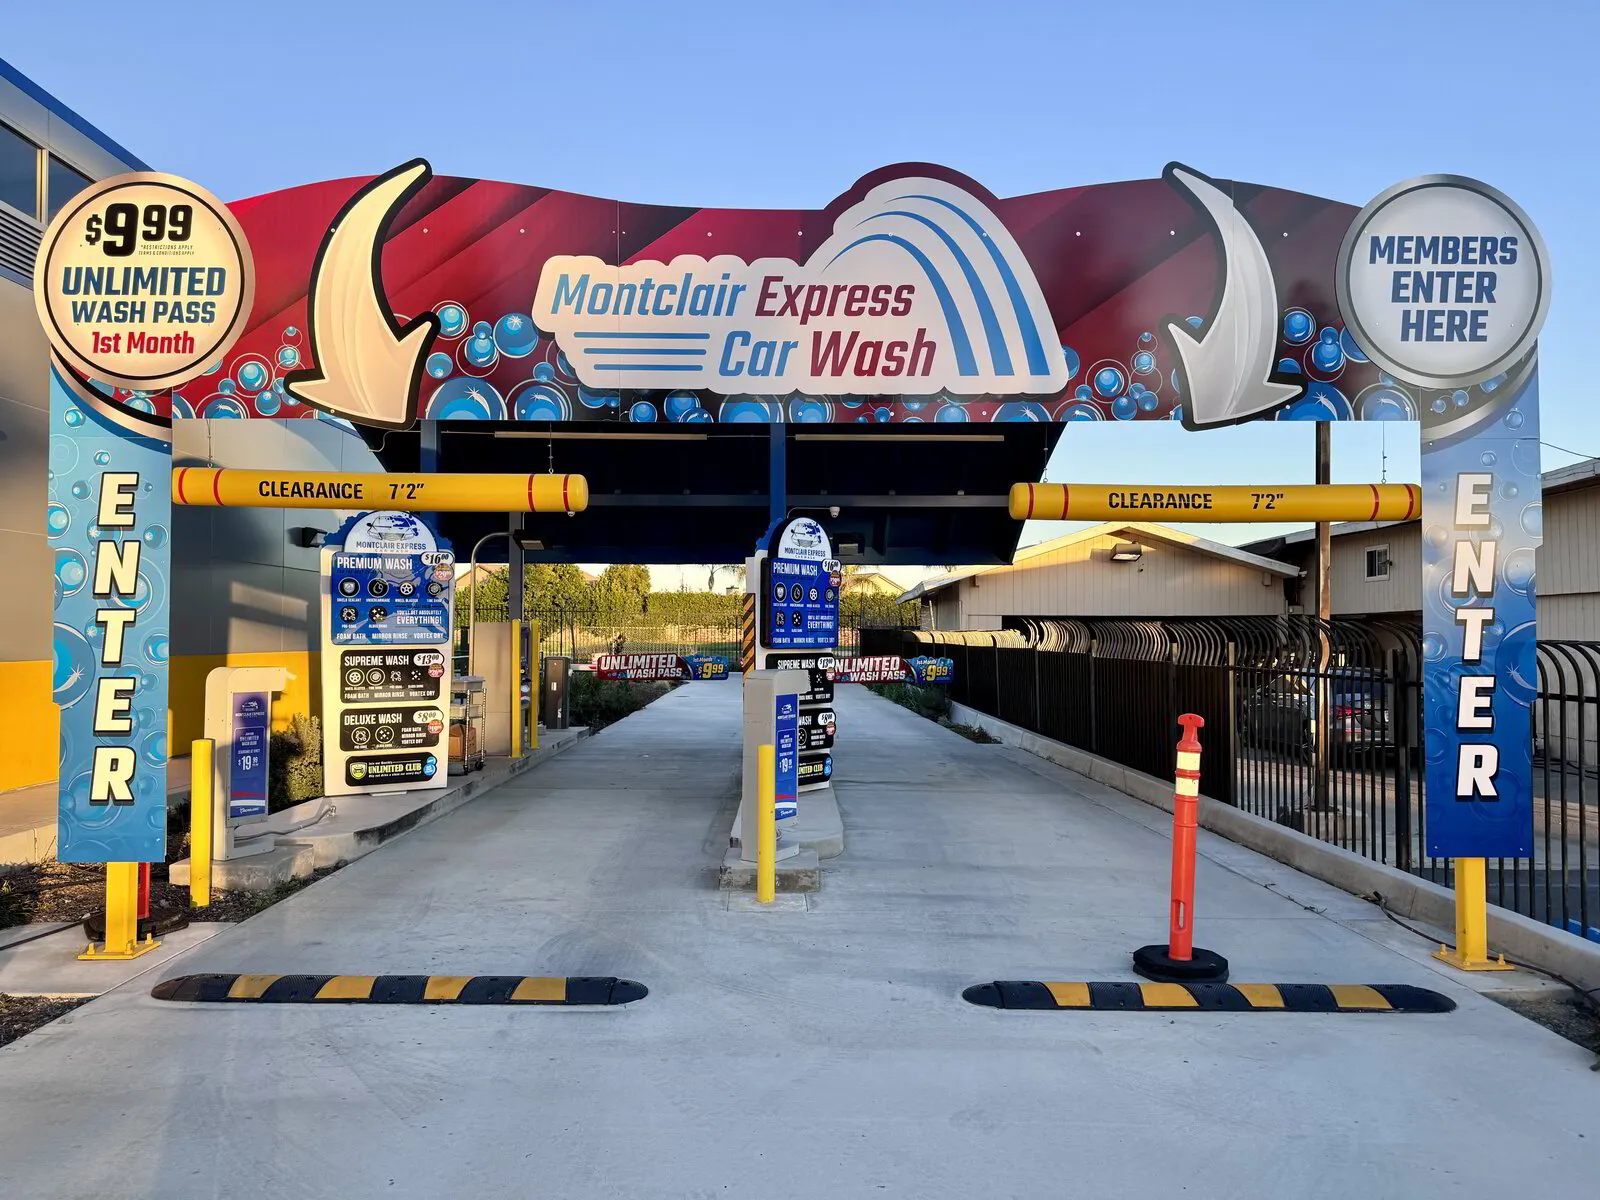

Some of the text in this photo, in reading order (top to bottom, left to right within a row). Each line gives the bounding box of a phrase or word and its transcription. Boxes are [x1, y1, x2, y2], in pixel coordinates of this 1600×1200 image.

[1369, 236, 1518, 265] MEMBERS
[62, 266, 226, 296] UNLIMITED
[1391, 271, 1497, 303] ENTER
[551, 273, 915, 325] Montclair Express
[72, 301, 216, 324] WASH PASS
[1401, 310, 1489, 342] HERE
[92, 330, 195, 354] 1st Month
[719, 328, 937, 377] Car Wash
[259, 481, 425, 500] CLEARANCE 7'2"
[1108, 492, 1284, 510] CLEARANCE 7'2"
[356, 541, 395, 550] MONTCLAIR
[785, 547, 807, 556] MONTCLAIR
[337, 557, 412, 570] PREMIUM WASH
[773, 562, 817, 576] PREMIUM WASH
[396, 616, 442, 624] EVERYTHING!
[90, 472, 141, 805] ENTER
[1453, 472, 1499, 801] ENTER
[344, 655, 409, 666] SUPREME WASH
[600, 654, 677, 670] UNLIMITED
[777, 659, 815, 669] SUPREME WASH
[835, 656, 900, 672] NLIMITED
[626, 669, 656, 678] WASH
[657, 668, 682, 677] PASS
[850, 672, 879, 681] WASH
[881, 671, 906, 680] PASS
[344, 713, 402, 725] DELUXE WASH
[368, 764, 404, 774] UNLIMITED
[405, 763, 422, 771] CLUB
[814, 764, 823, 772] CLUB
